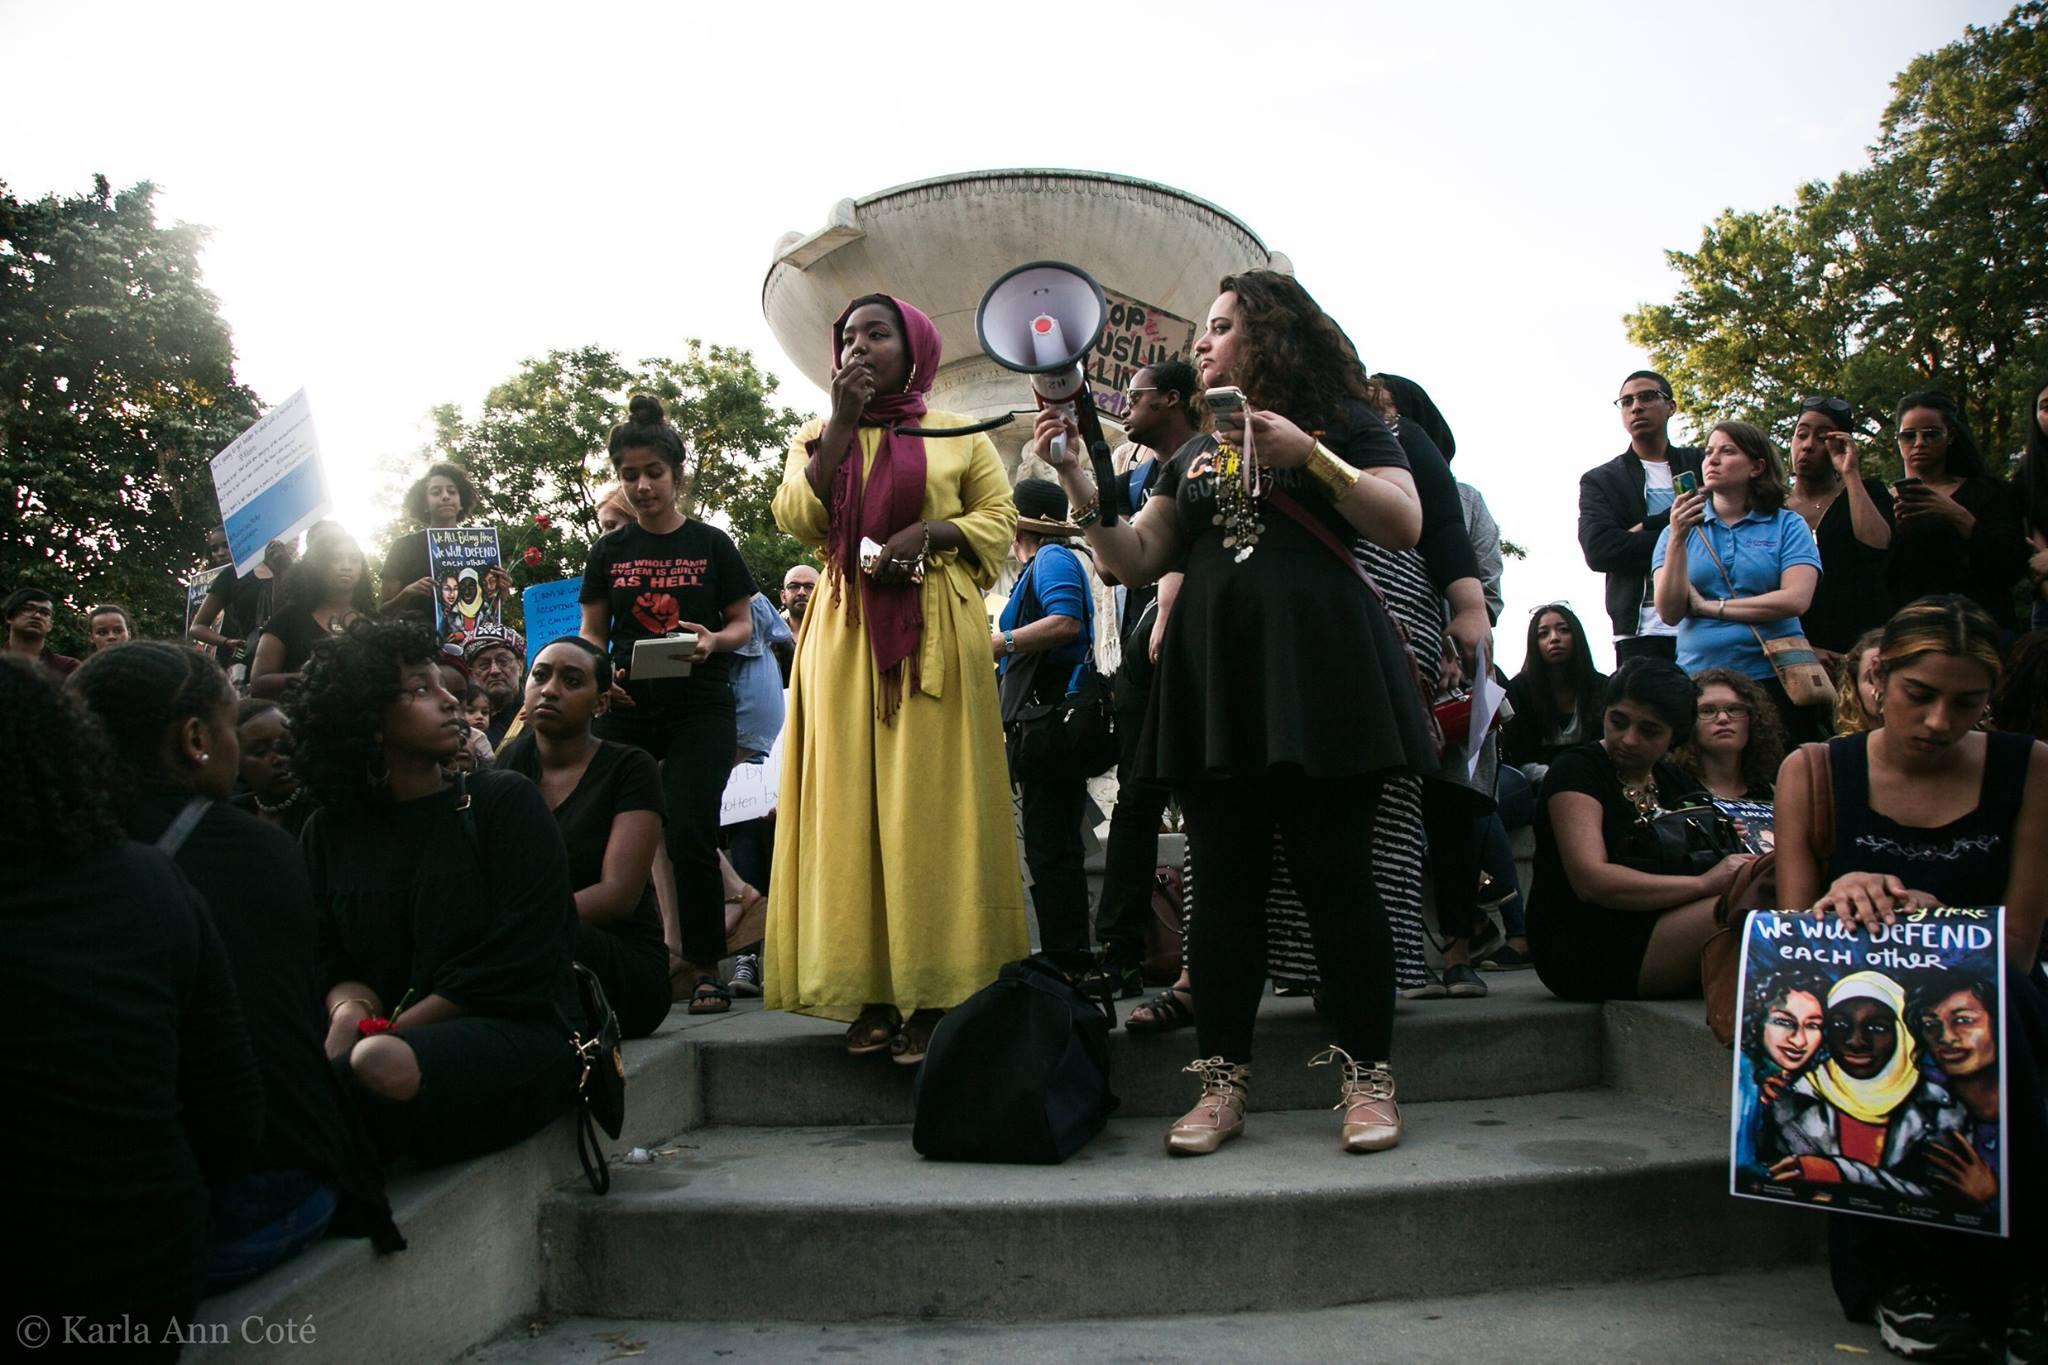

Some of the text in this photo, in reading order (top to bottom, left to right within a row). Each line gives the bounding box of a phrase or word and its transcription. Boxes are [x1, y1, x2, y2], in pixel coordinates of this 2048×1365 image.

[1106, 298, 1145, 332] OP
[610, 566, 707, 576] SYSTEM IS GUILTY
[634, 559, 672, 568] WHOLE
[675, 559, 707, 567] DAMN
[613, 575, 703, 588] AS HELL
[721, 797, 757, 814] otten
[1756, 917, 1793, 939] We
